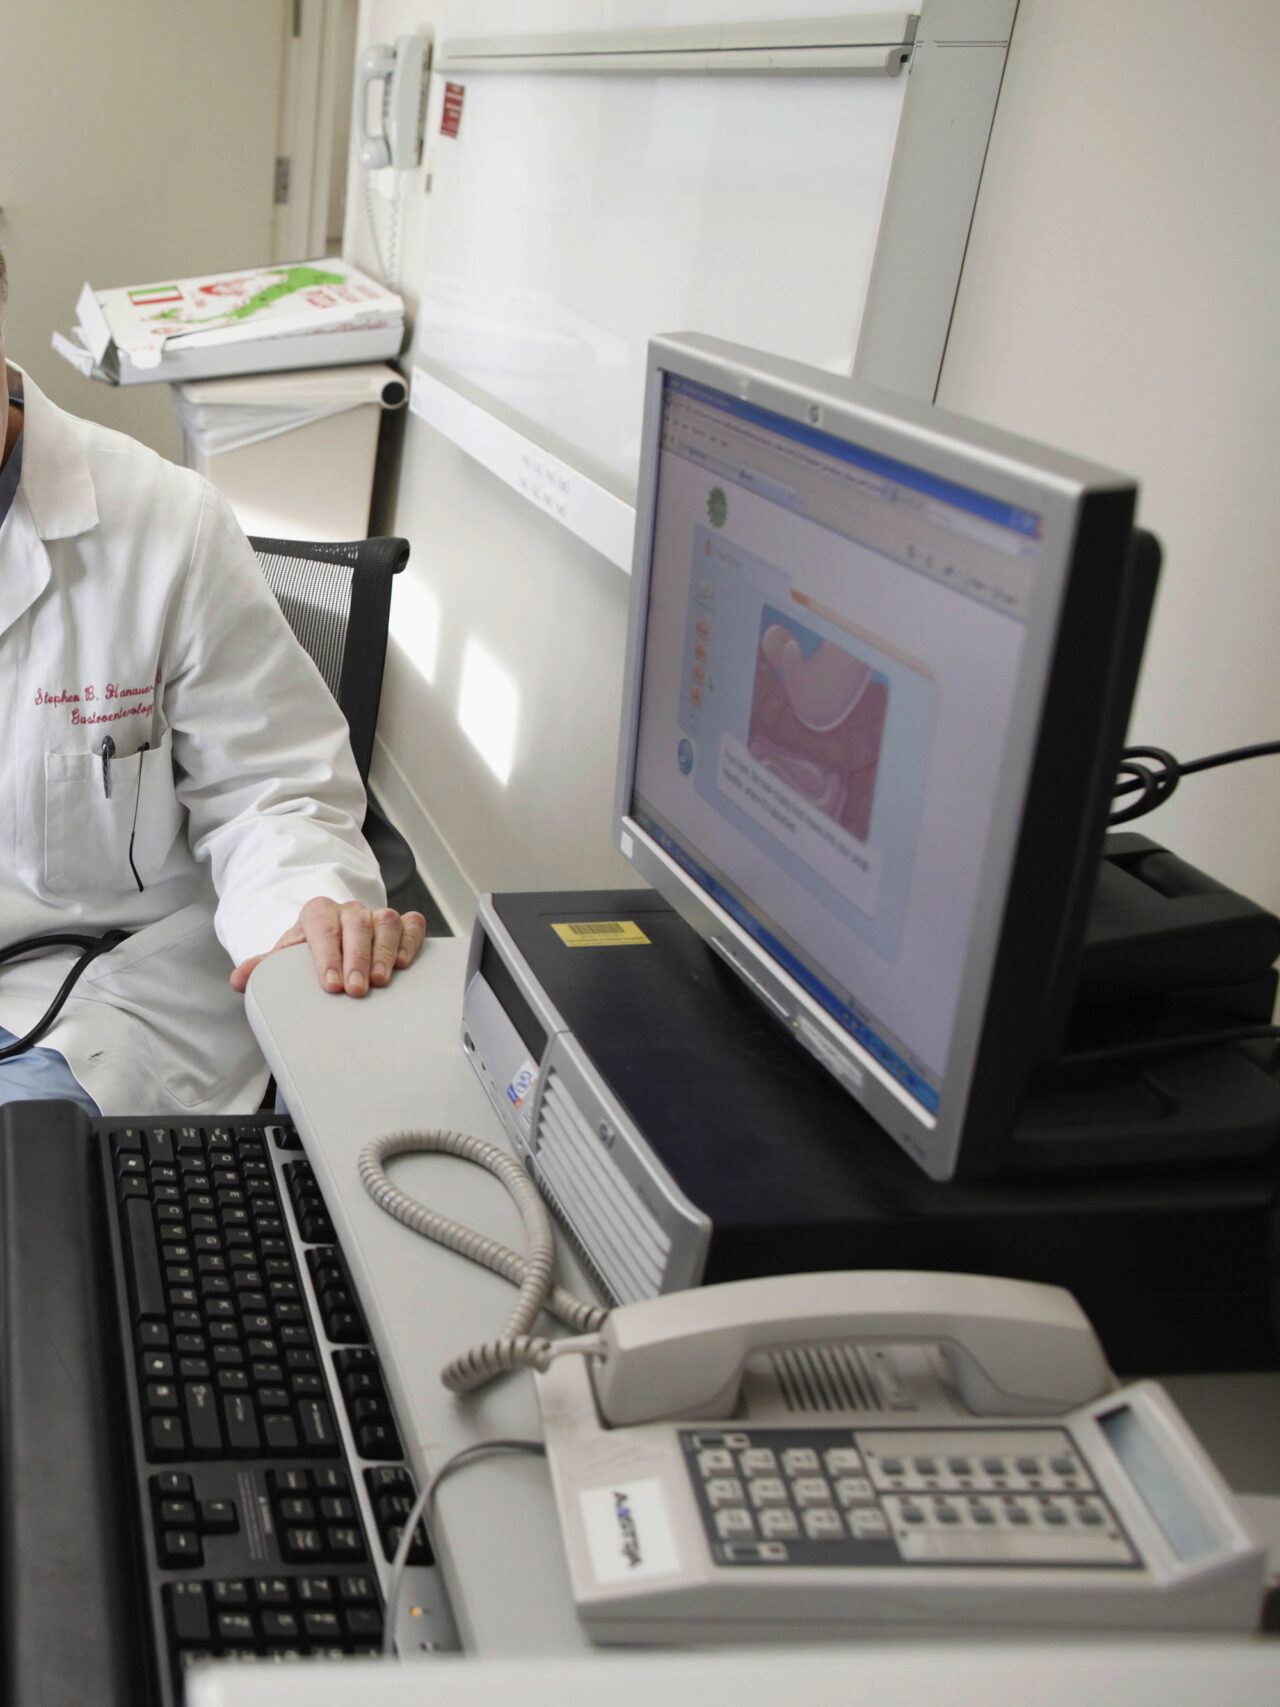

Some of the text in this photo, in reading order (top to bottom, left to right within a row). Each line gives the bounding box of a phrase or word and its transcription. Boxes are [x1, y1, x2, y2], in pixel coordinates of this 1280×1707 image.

[34, 687, 80, 708] Stephen
[169, 1206, 179, 1214] C
[256, 1317, 267, 1326] O
[262, 1341, 273, 1349] P
